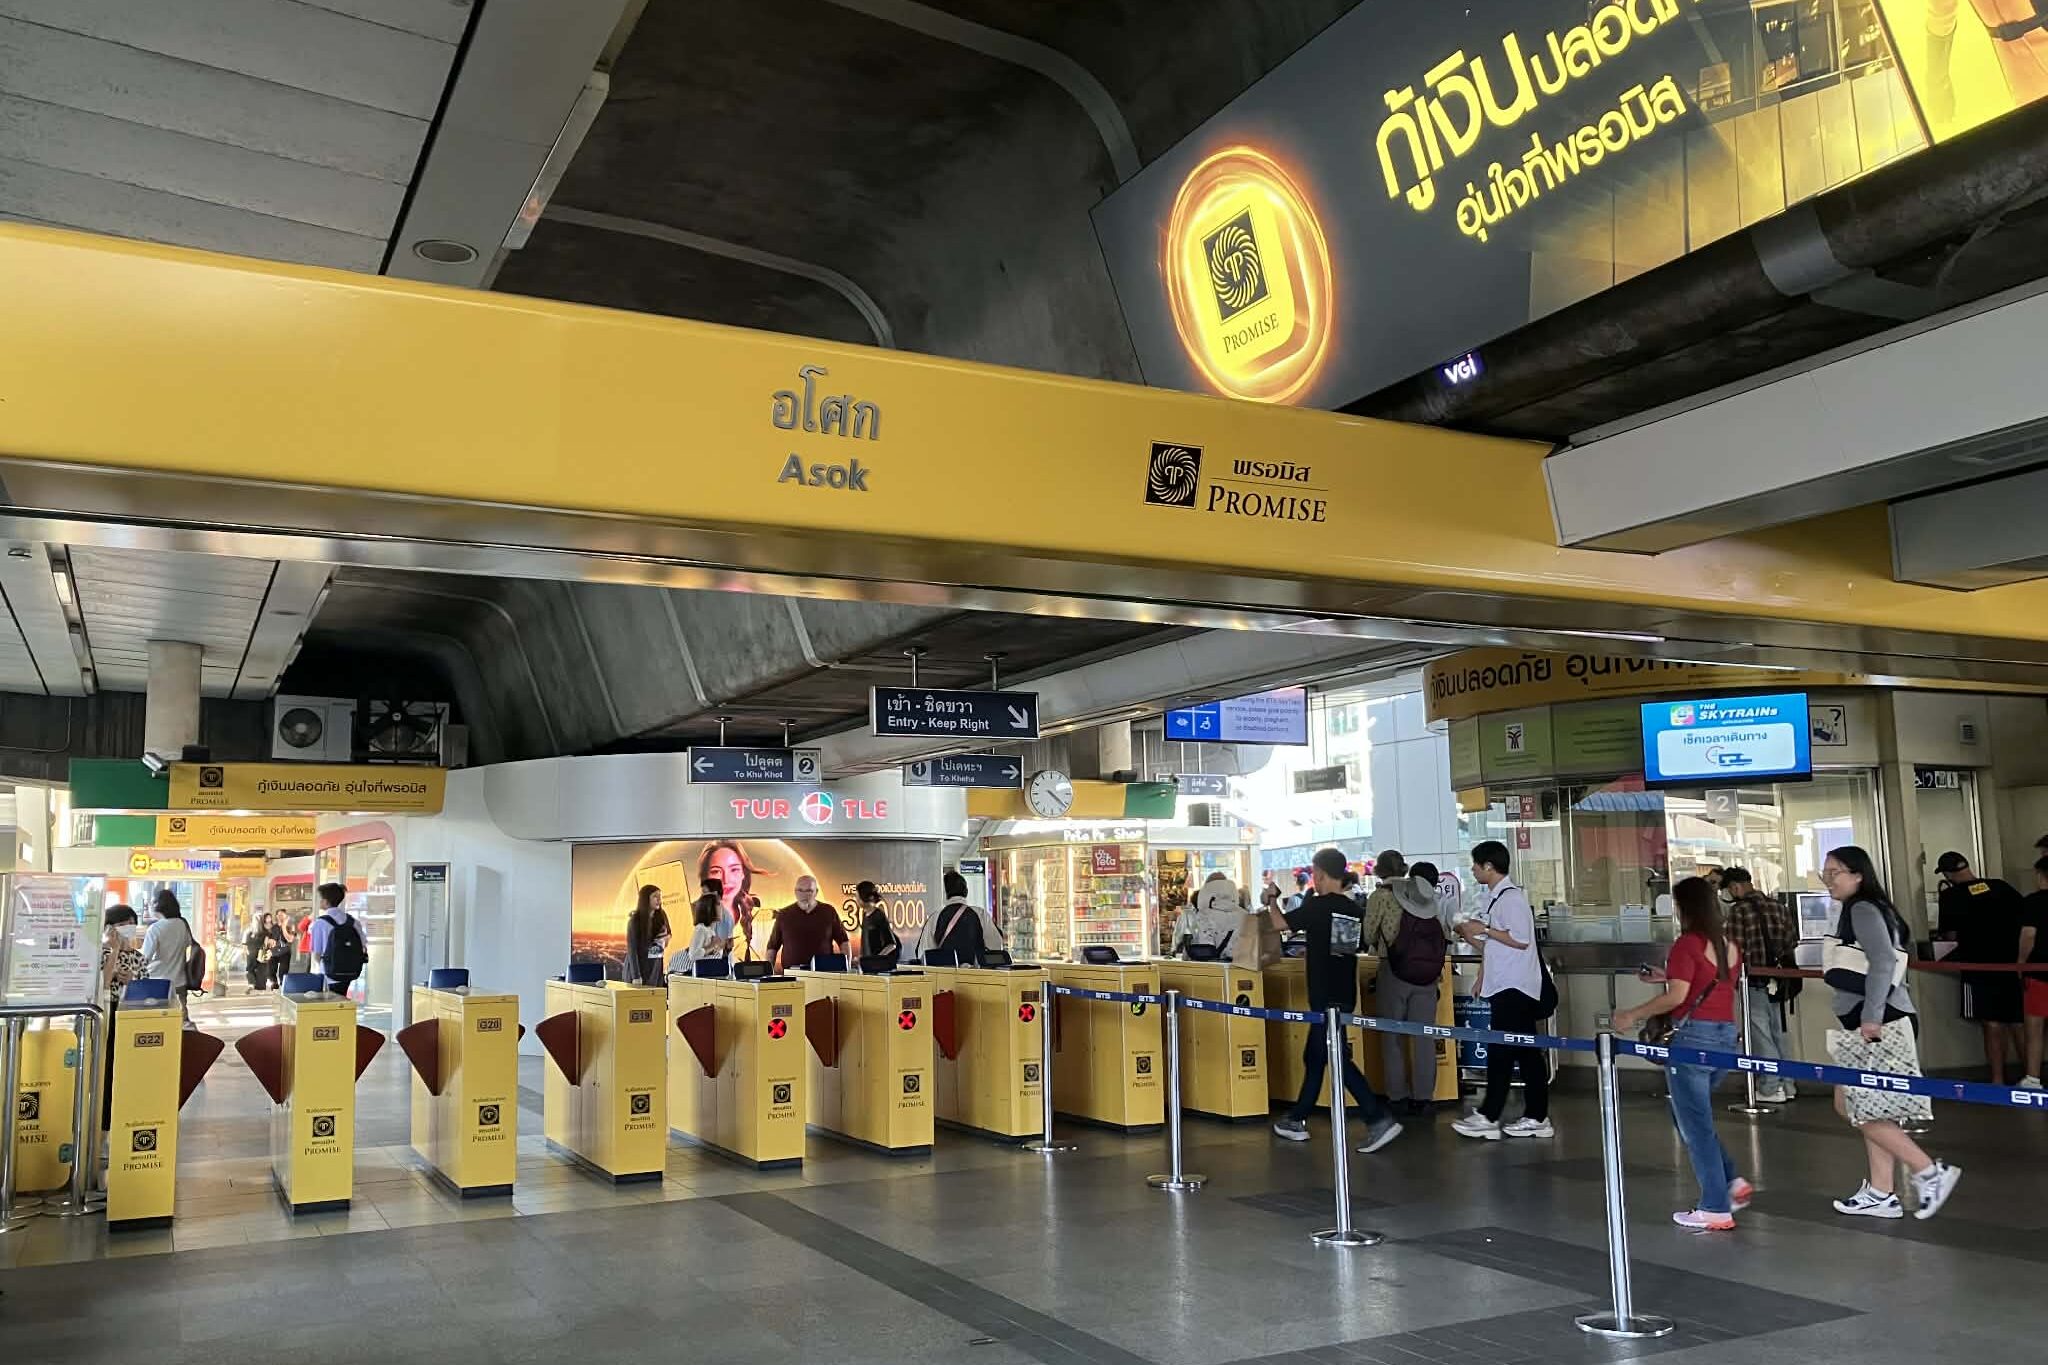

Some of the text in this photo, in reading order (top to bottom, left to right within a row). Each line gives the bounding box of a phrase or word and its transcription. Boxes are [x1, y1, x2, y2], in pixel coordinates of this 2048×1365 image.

[1376, 0, 1680, 210] กู้เงินปลอด
[1456, 75, 1687, 242] อุ่นใจที่พรอมิส
[1222, 313, 1280, 354] PROMISE
[772, 365, 880, 441] อโศก
[778, 453, 870, 491] Asok
[1233, 459, 1311, 482] พรอมิส
[1206, 485, 1328, 522] PROMISE
[887, 694, 911, 712] เข้า
[925, 695, 973, 714] ชิดขวา
[888, 717, 918, 730] Entry
[929, 717, 957, 731] Keep
[960, 718, 990, 732] Right
[744, 753, 783, 771] ไปคูคต
[802, 759, 812, 773] 2
[747, 770, 762, 778] Khu
[940, 774, 949, 782] To
[258, 779, 427, 796] กู้เงินปลอดภัย อุ่นใจที่พรอมิส
[731, 799, 888, 819] TUR TLE
[1715, 796, 1731, 812] 2
[1186, 1000, 1203, 1008] BTS
[1232, 1007, 1250, 1015] BTS
[1283, 1012, 1304, 1020] BTS
[1353, 1017, 1377, 1027] BTS
[1424, 1026, 1451, 1036] BTS
[137, 1035, 162, 1045] G22
[1503, 1034, 1536, 1044] BTS
[1635, 1044, 1669, 1058] BTS
[1737, 1058, 1778, 1073] BTS
[1861, 1073, 1910, 1091] BTS
[18, 1133, 48, 1143] MISE
[123, 1162, 164, 1171] PROMISE
